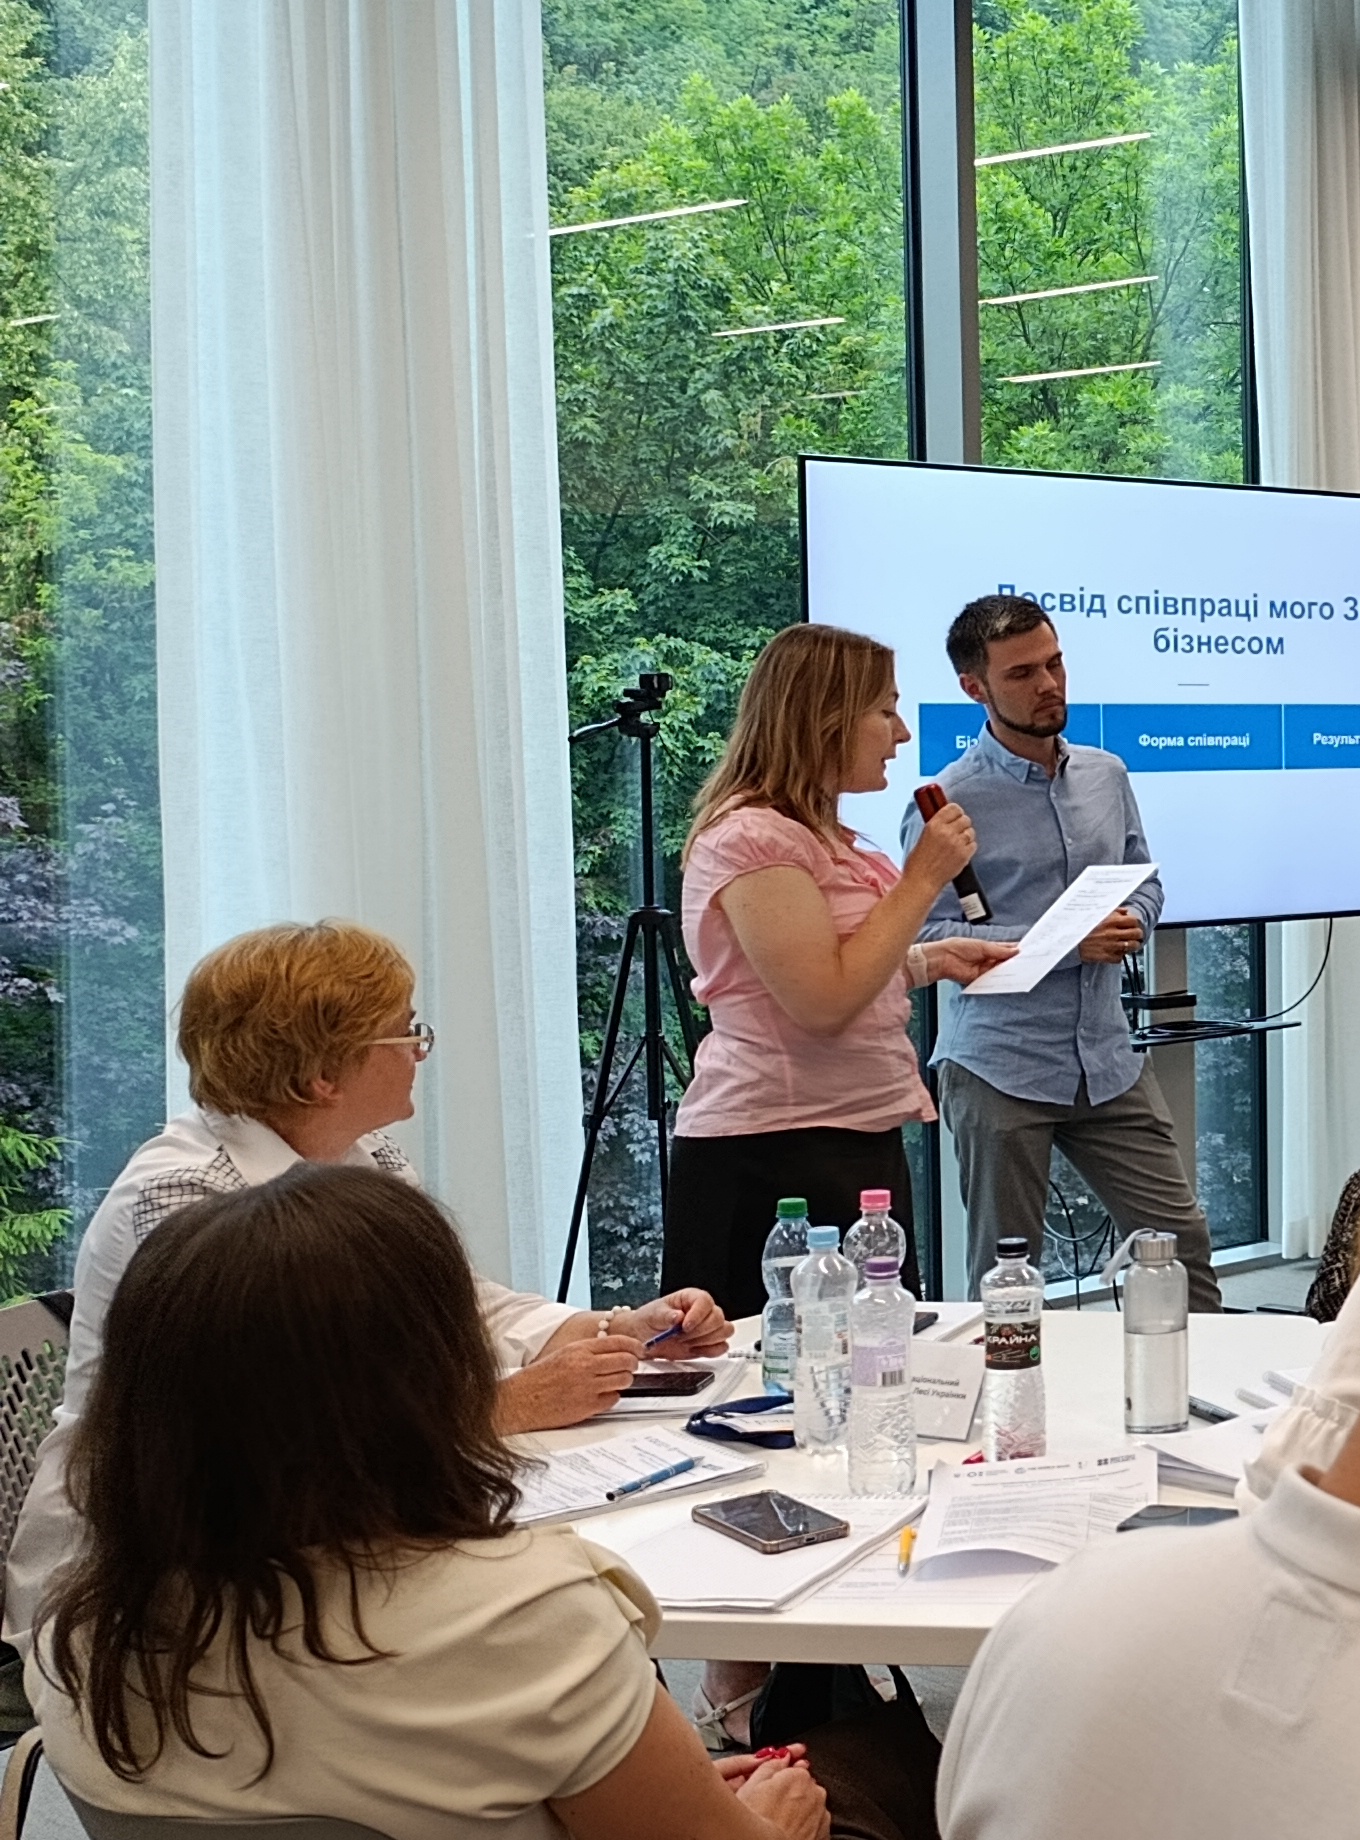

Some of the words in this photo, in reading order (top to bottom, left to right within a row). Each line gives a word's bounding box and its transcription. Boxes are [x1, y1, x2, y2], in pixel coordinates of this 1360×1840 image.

[1117, 589, 1258, 623] співпраці
[1269, 600, 1335, 620] мого
[1153, 626, 1285, 655] бізнесом
[1138, 733, 1184, 749] Форма
[1187, 732, 1250, 748] співпраці
[911, 1375, 960, 1387] аціональний
[931, 1389, 967, 1400] Українки
